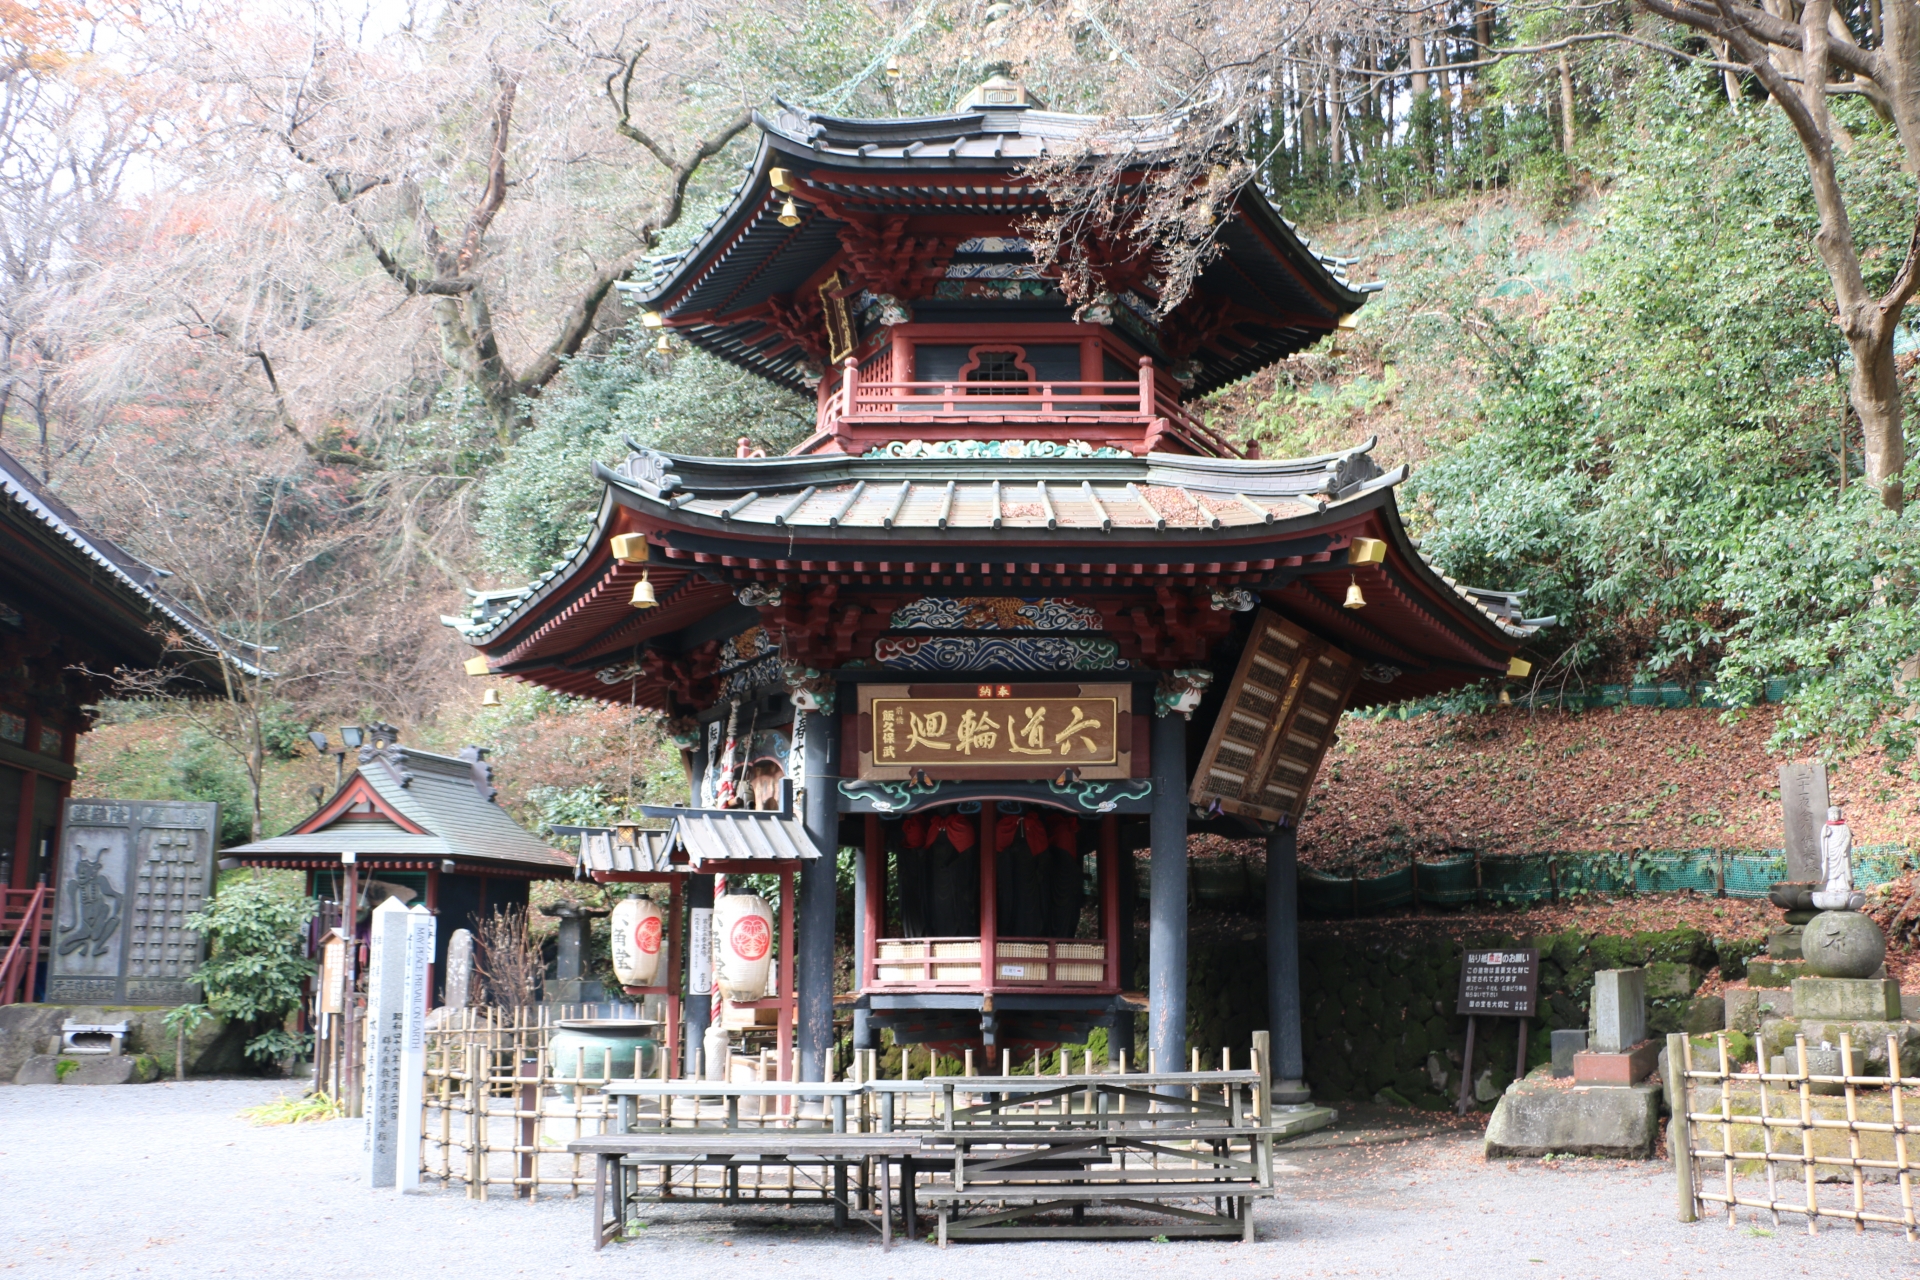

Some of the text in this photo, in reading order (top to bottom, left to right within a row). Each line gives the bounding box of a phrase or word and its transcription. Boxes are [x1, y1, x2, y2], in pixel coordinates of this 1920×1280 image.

[978, 685, 1011, 698] 奉納
[882, 710, 896, 759] 飯久保武
[412, 927, 425, 1049] MAY PEACE PREVAIL ON EARTH
[1468, 953, 1529, 964] 貼り紙禁止のお願い
[376, 1036, 392, 1154] 群馬県教育委員会指定
[390, 1012, 403, 1120] 昭和四十八年十二月二十四日
